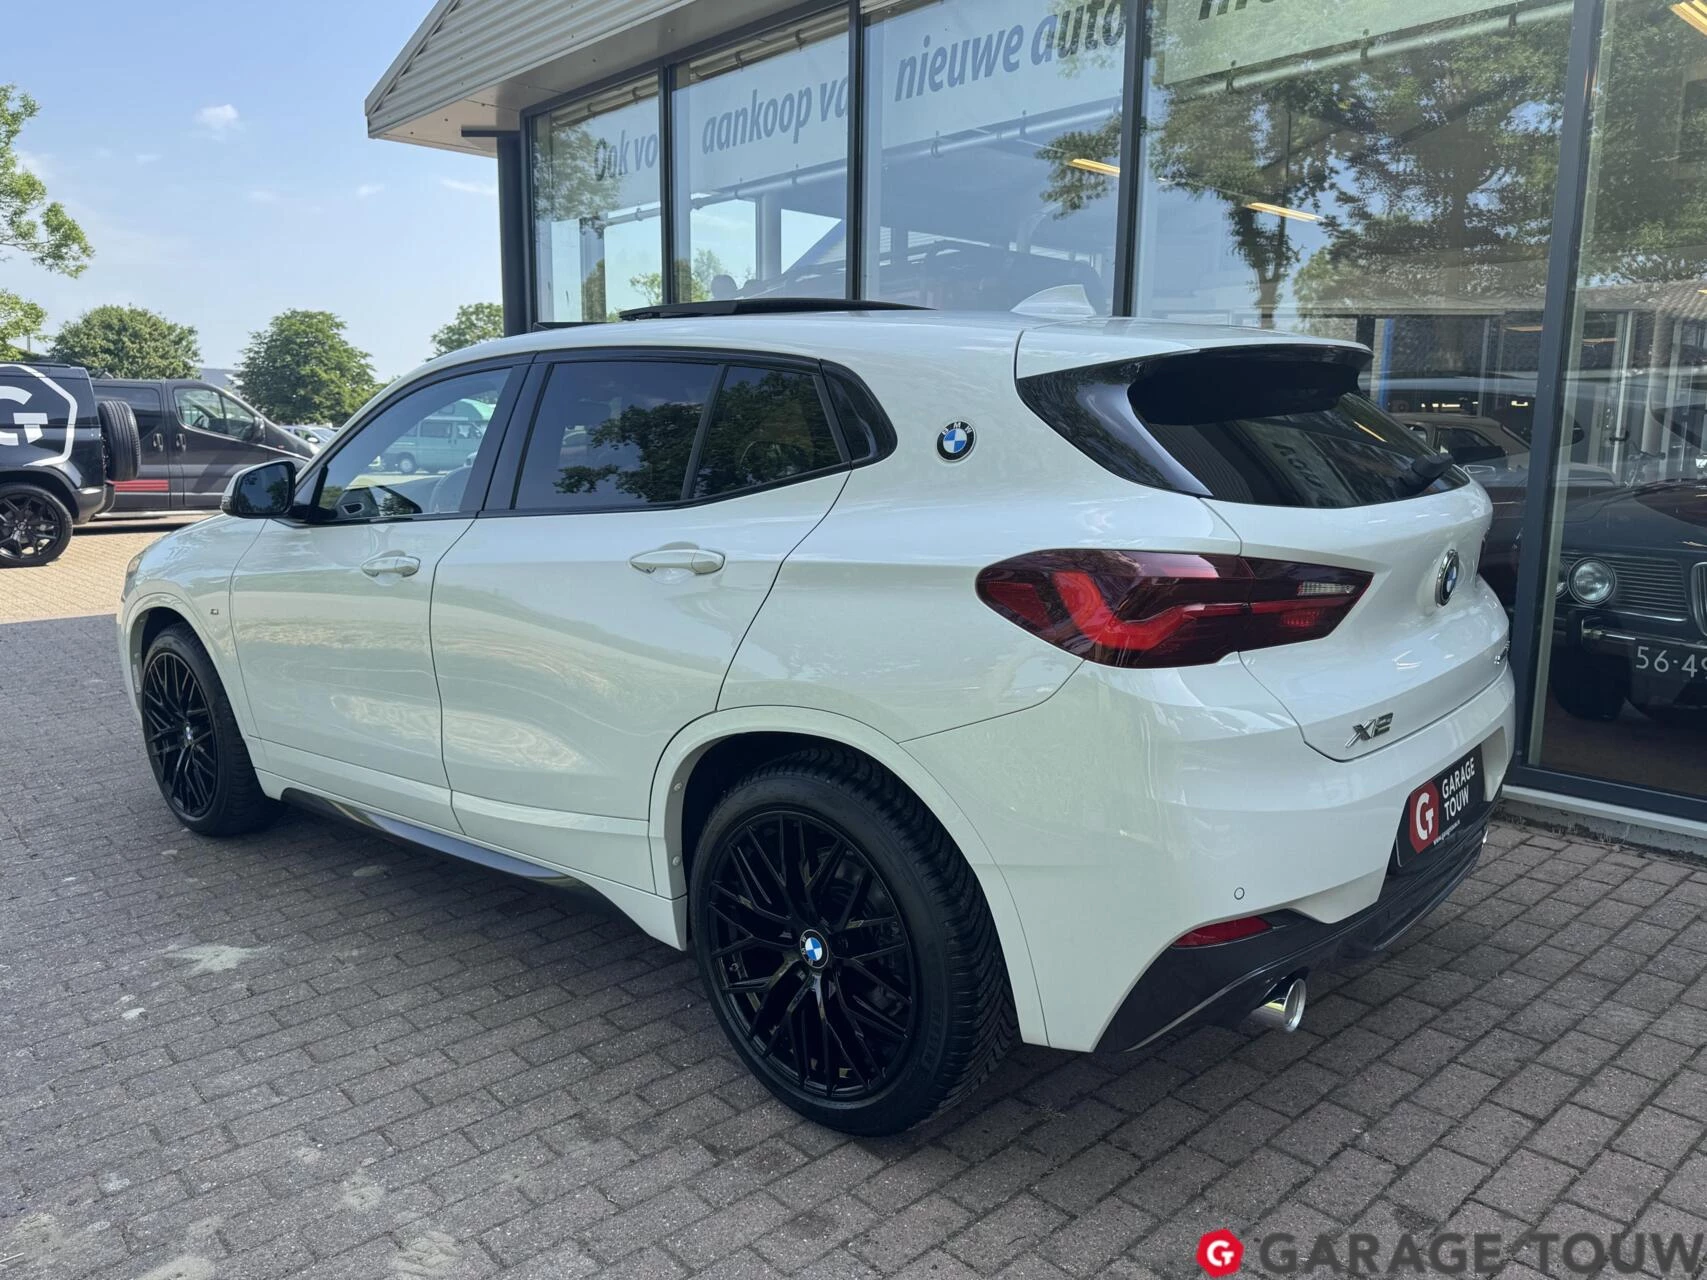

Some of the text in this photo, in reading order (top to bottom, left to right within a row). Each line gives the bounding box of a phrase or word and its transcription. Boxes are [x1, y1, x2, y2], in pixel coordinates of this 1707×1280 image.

[702, 83, 812, 154] aankoop
[895, 25, 1024, 102] nieuwe
[1030, 0, 1126, 66] auto
[1442, 757, 1475, 799] GARAGE
[1444, 784, 1469, 820] TOUW
